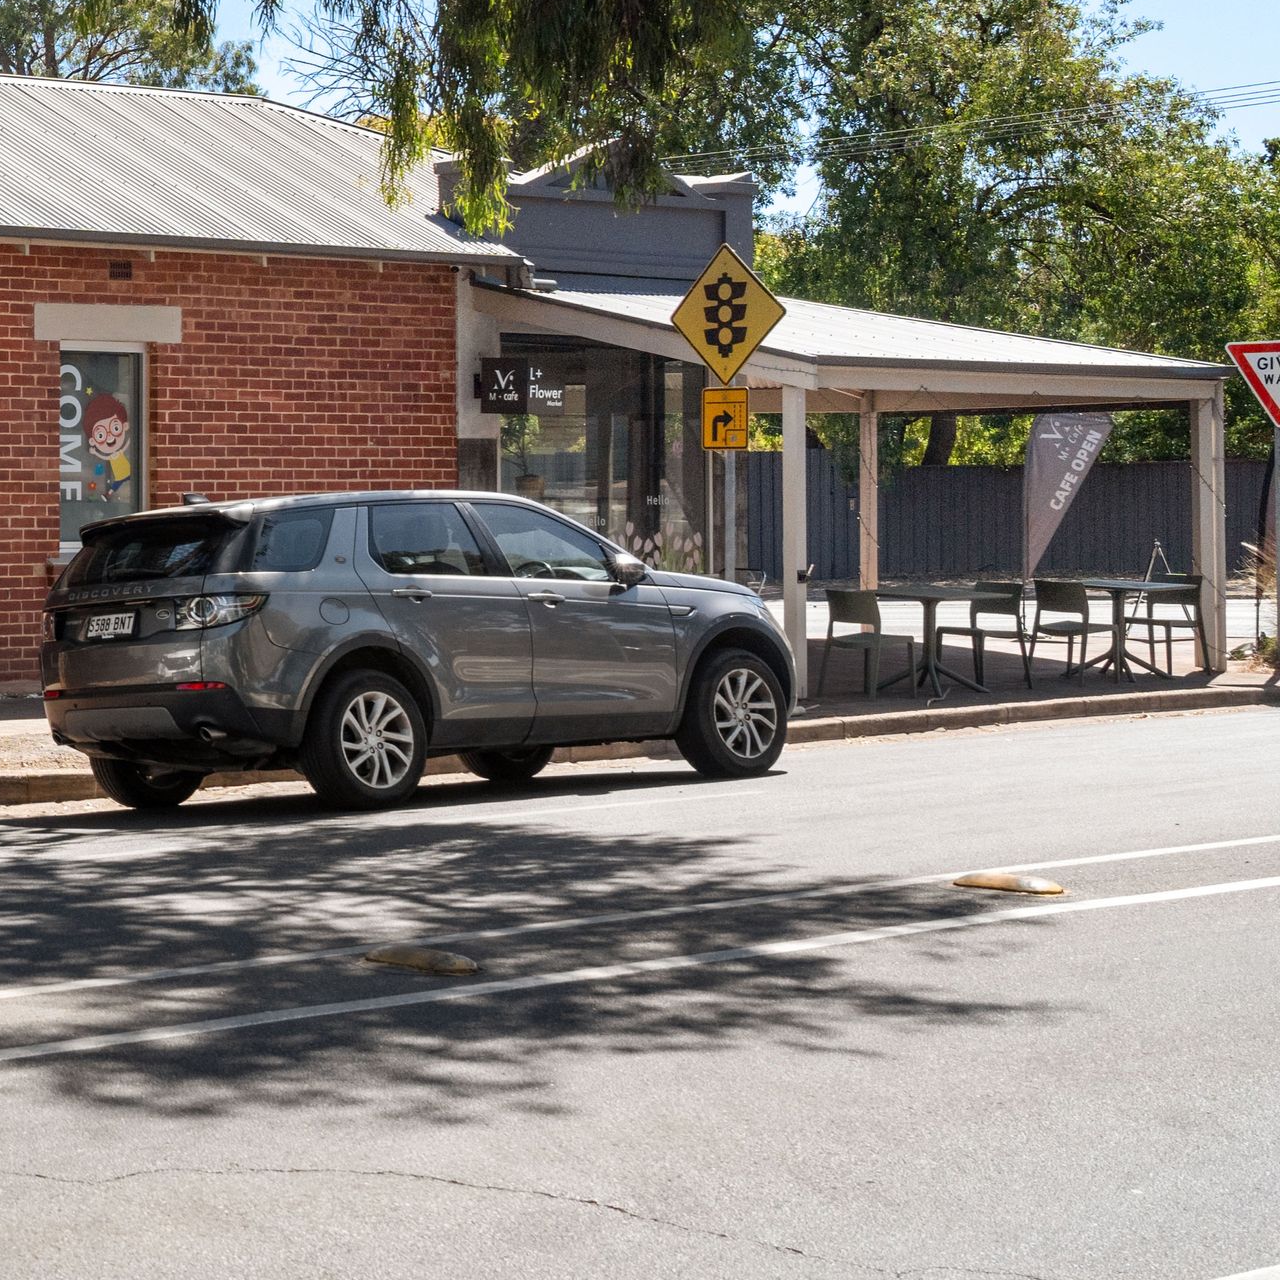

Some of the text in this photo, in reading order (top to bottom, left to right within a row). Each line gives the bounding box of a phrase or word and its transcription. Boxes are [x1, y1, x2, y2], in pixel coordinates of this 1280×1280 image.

[529, 367, 543, 380] L+
[503, 391, 519, 401] cafe
[529, 384, 563, 399] Flower
[1050, 429, 1102, 510] CAFE OPEN
[646, 495, 670, 505] Hello
[68, 585, 154, 600] DISCOVERY
